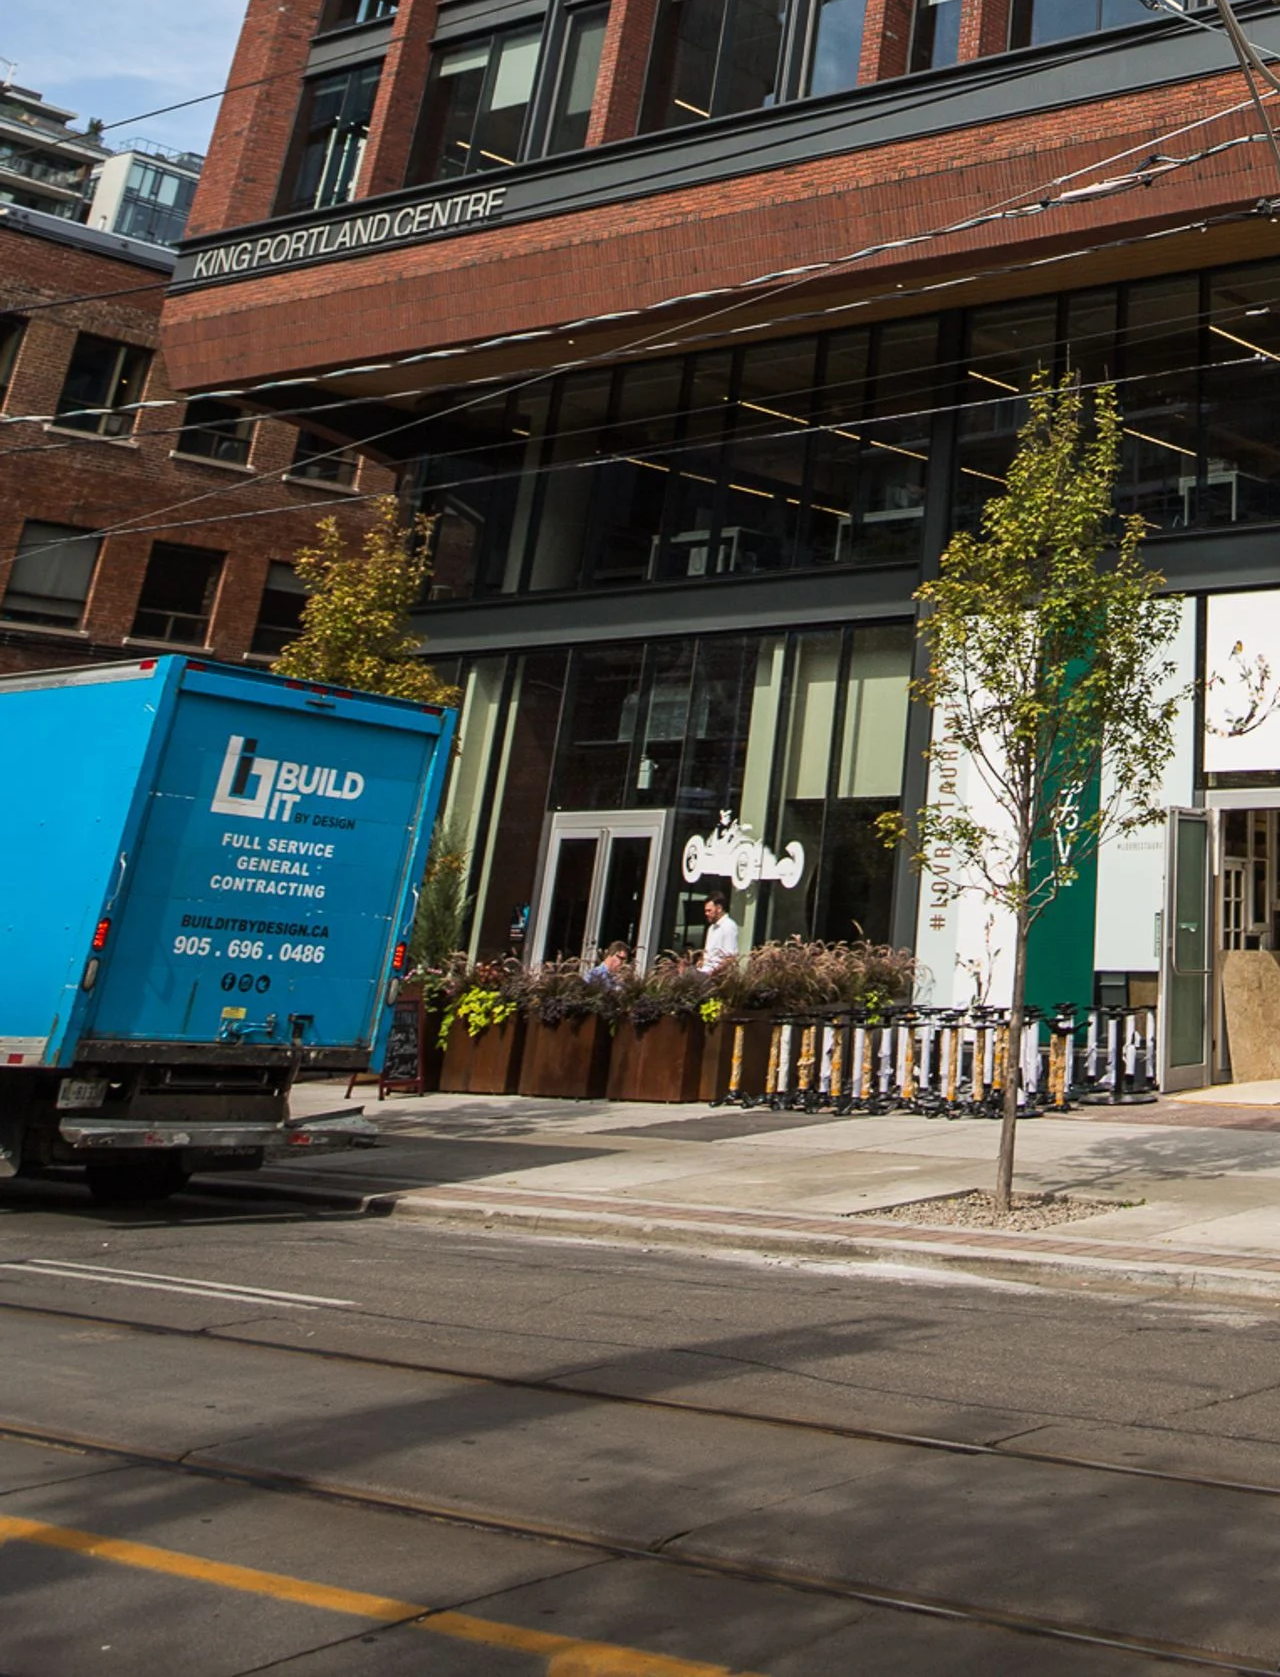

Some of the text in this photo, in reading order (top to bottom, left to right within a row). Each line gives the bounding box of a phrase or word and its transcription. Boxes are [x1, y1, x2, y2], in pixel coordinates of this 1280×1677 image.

[192, 242, 252, 279] KING
[251, 213, 390, 268] PORTLAND
[276, 761, 365, 800] BUILD
[268, 792, 301, 822] IT
[930, 702, 963, 930] #LOVRSTAURANT
[294, 812, 356, 830] BY DESIGN
[222, 833, 335, 858] FULL SERVICE
[236, 856, 310, 877] GENERAL
[210, 875, 326, 899] CONTRACTING
[180, 914, 329, 938] BUILDITBYDESIGN.CA
